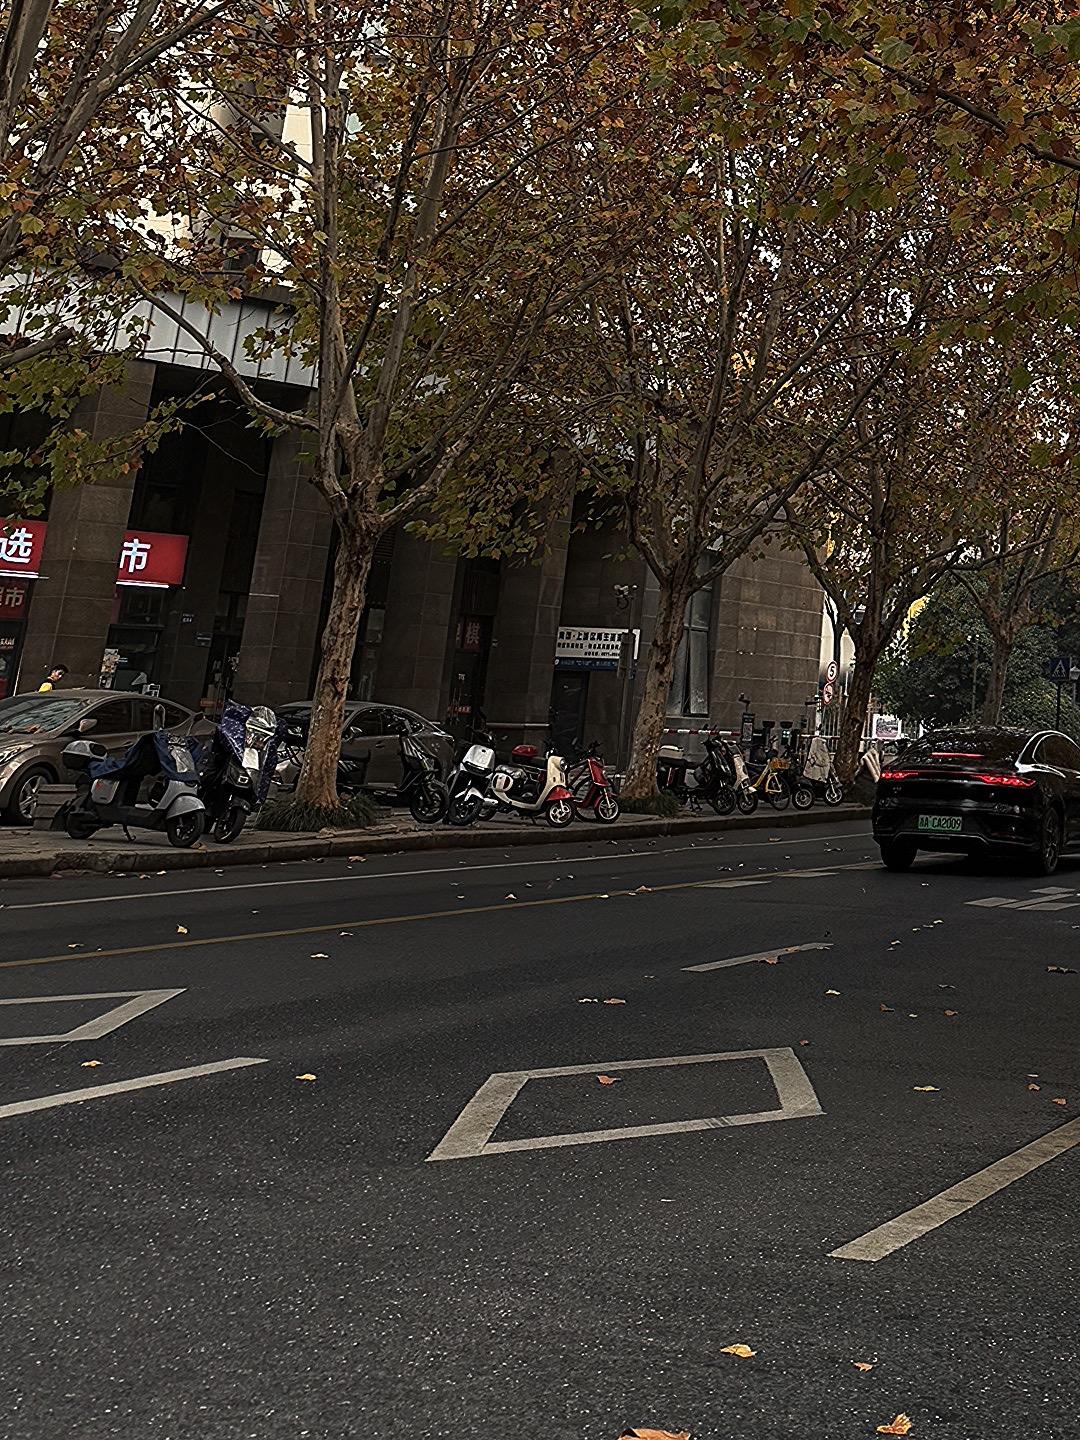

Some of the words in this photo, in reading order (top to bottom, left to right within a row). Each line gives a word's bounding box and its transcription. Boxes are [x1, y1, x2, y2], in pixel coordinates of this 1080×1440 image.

[0, 527, 33, 564] 选
[119, 538, 151, 572] 市
[830, 665, 835, 677] 5
